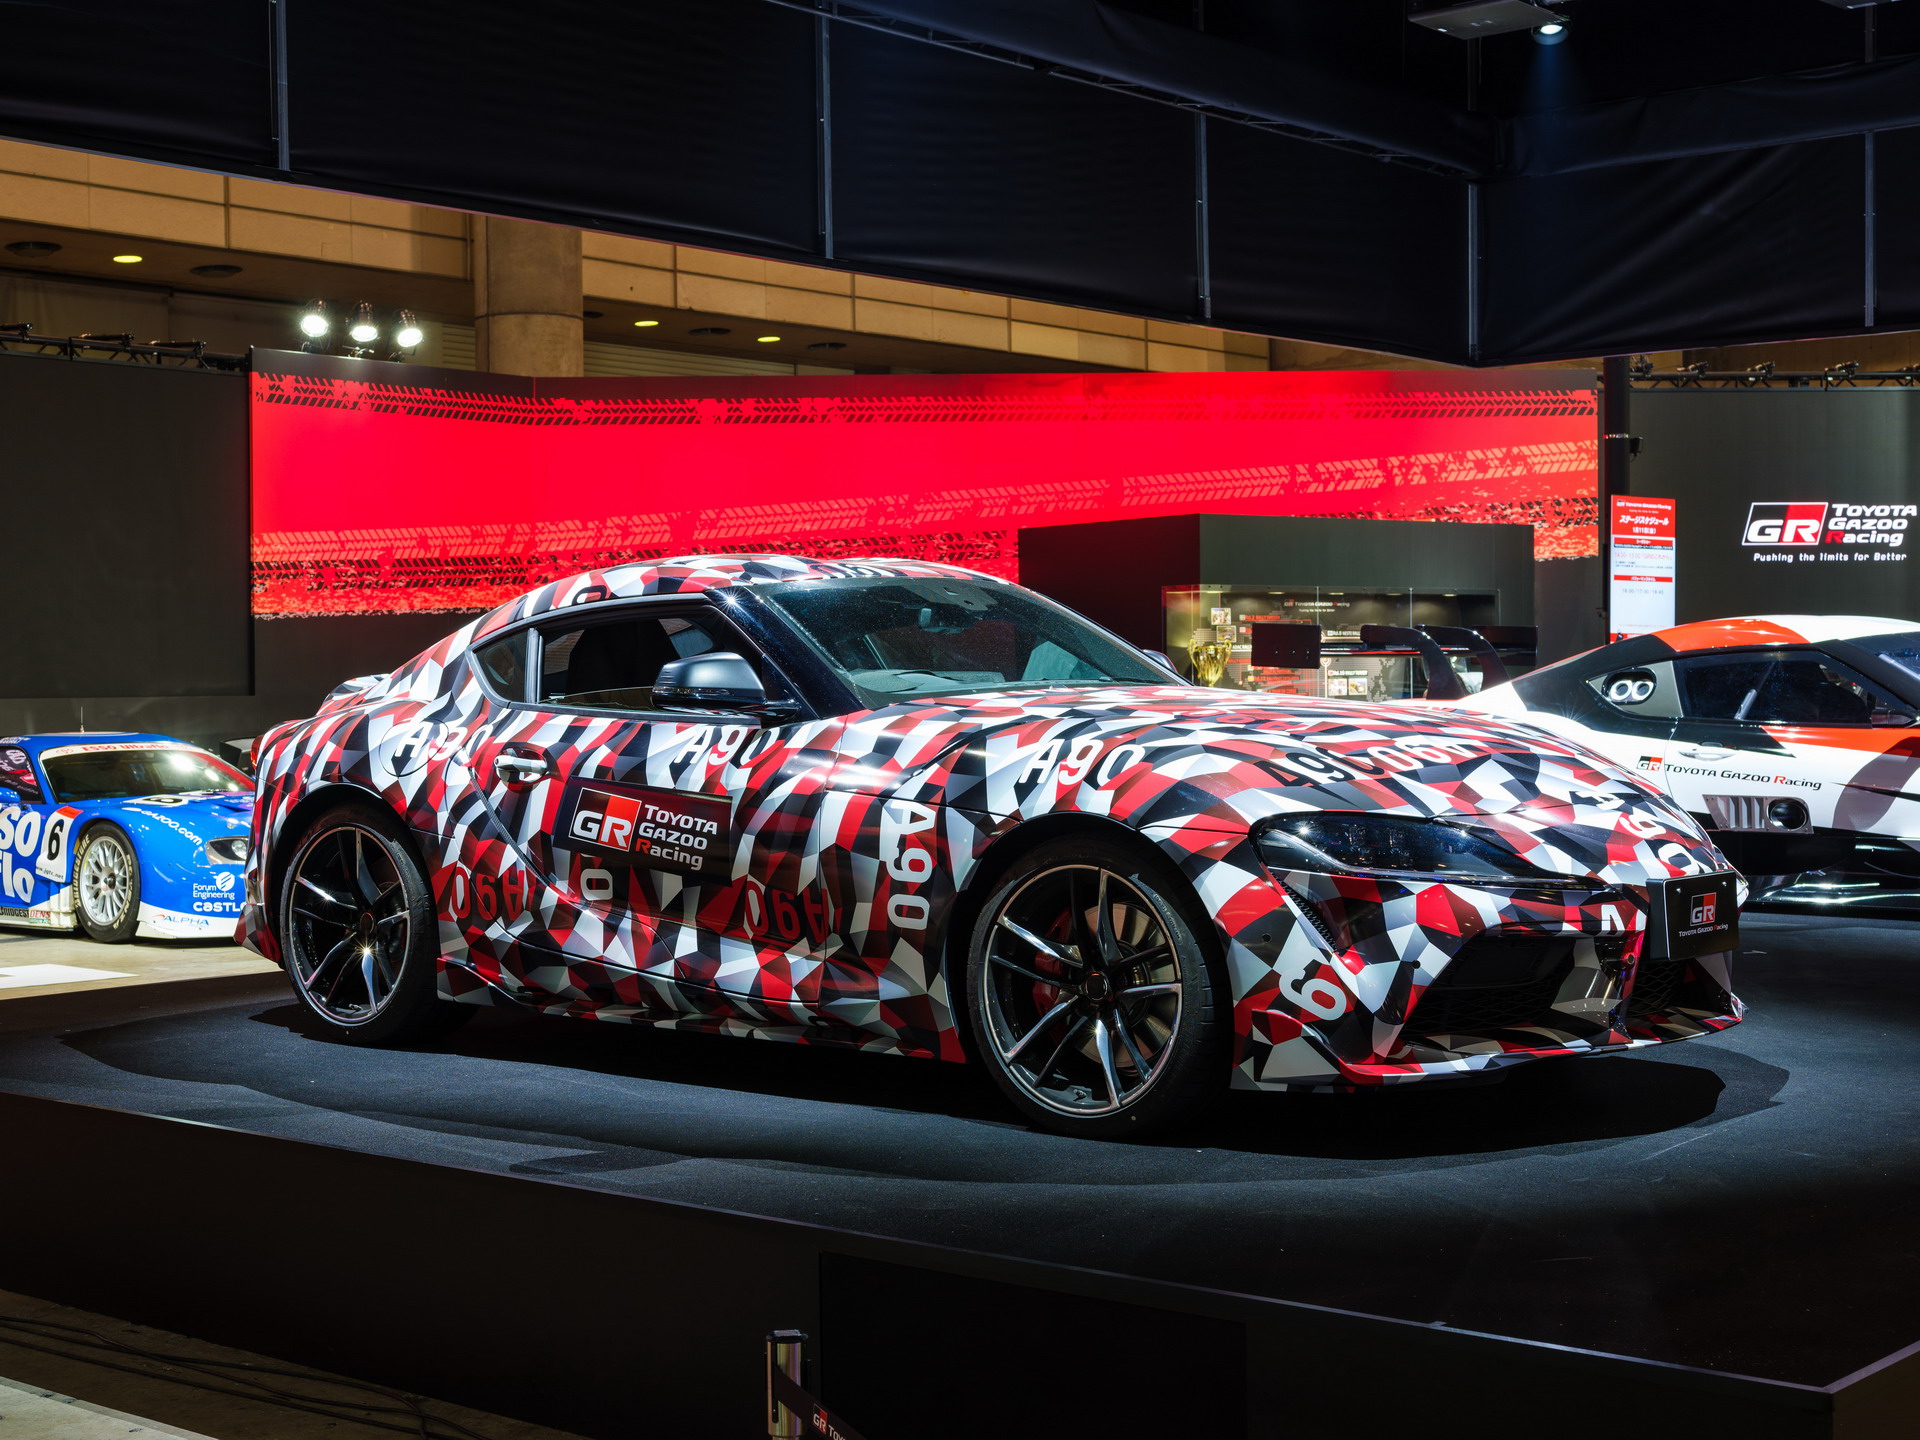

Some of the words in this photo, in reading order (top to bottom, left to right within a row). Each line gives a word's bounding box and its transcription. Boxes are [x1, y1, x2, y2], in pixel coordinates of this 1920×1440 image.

[1832, 503, 1917, 517] TOYOTA
[1746, 519, 1820, 543] GR
[1828, 517, 1908, 530] GAZOO
[1825, 530, 1904, 547] Racing
[1753, 552, 1794, 563] Pushing
[1799, 552, 1815, 562] the
[1820, 552, 1849, 562] limits
[1854, 552, 1869, 562] for
[1873, 552, 1907, 562] Better
[674, 725, 779, 766] A90
[1019, 738, 1146, 786] A90
[1637, 760, 1663, 771] GR
[1664, 763, 1717, 777] TOYOTA
[1720, 769, 1771, 783] GAZOO
[1773, 774, 1823, 792] Racing
[573, 810, 632, 848] GR
[644, 804, 718, 835] TOYOTA
[47, 818, 65, 861] 6
[638, 822, 708, 851] GAZOO
[635, 838, 703, 871] Racing
[886, 802, 935, 930] A90
[193, 883, 217, 892] Forum
[193, 891, 235, 900] Engineering
[164, 915, 210, 926] ALPHA
[1692, 905, 1714, 923] GR
[1679, 929, 1697, 937] TOYOTA
[1697, 926, 1713, 934] GAZOO
[813, 1413, 826, 1432] GR
